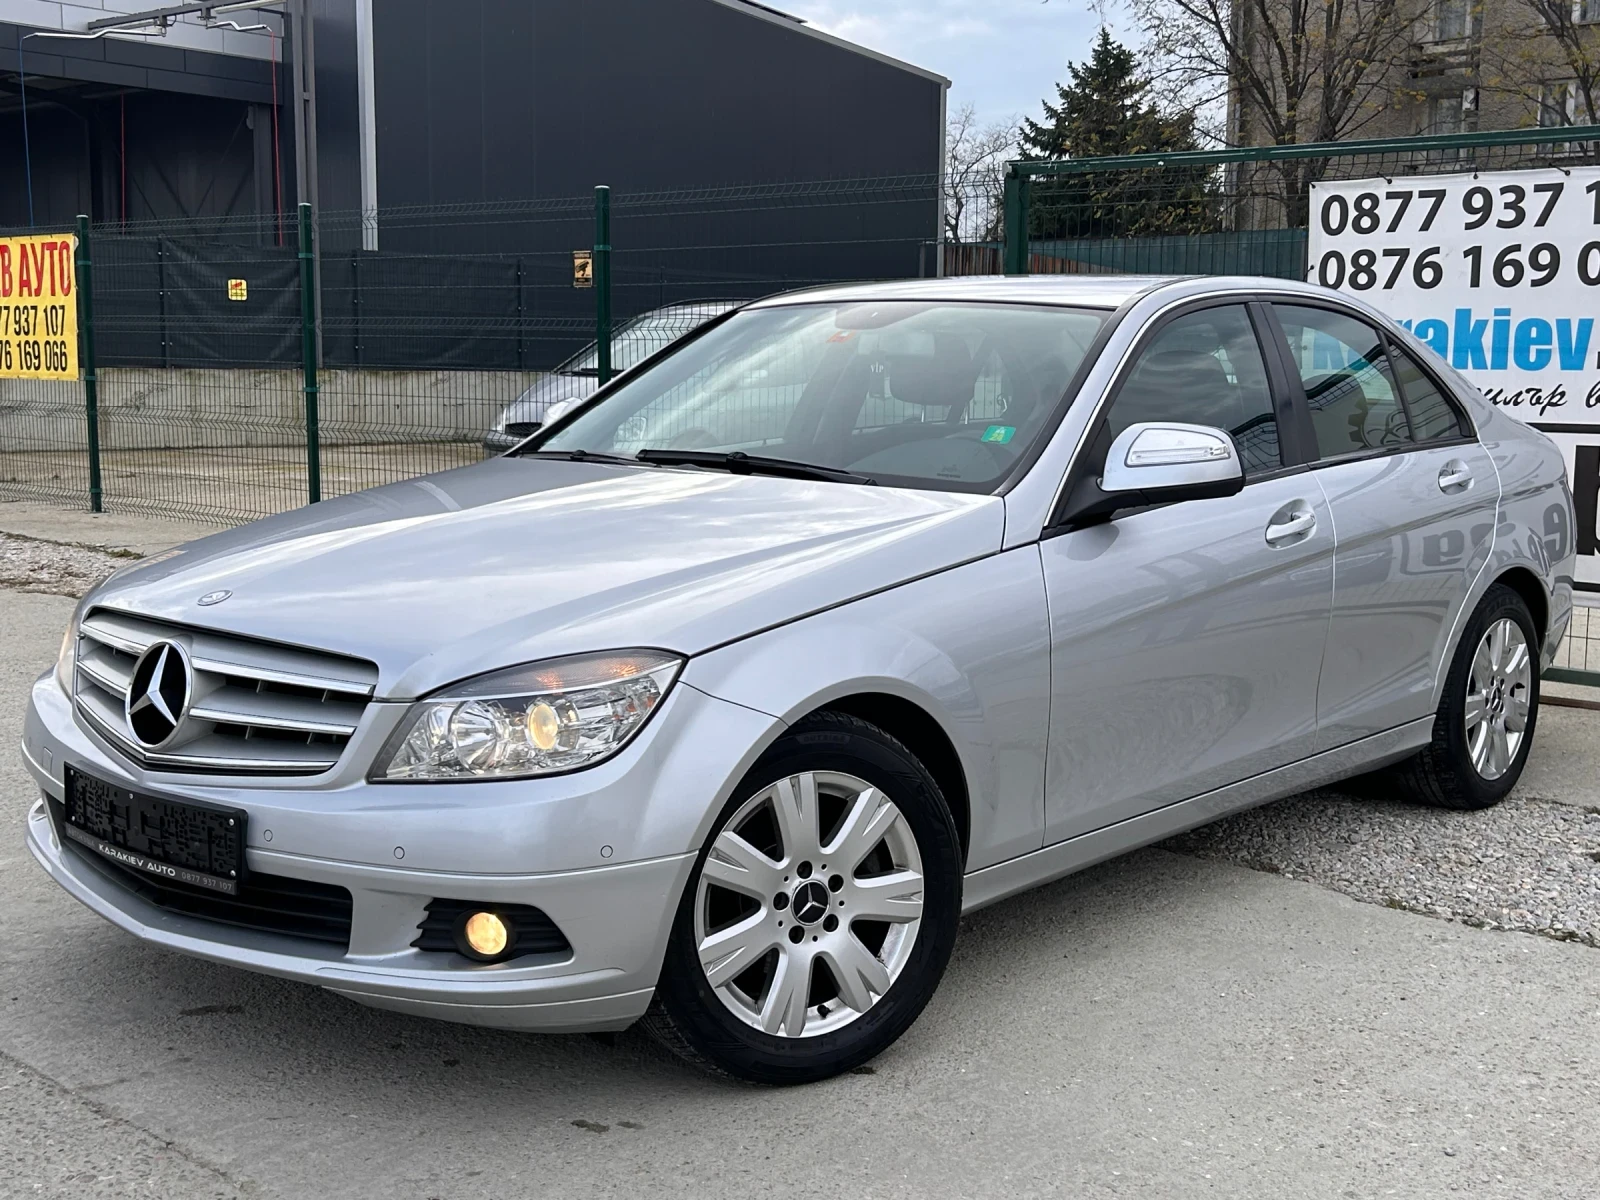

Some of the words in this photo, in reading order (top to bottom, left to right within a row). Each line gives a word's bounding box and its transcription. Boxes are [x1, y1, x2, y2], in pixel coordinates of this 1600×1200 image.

[1321, 189, 1447, 236] 0877
[1462, 182, 1564, 230] 937
[19, 241, 71, 297] АУТО
[1318, 246, 1444, 291] 0876
[1463, 242, 1561, 288] 169
[14, 305, 38, 336] 937
[43, 304, 66, 336] 107
[16, 340, 41, 371] 169
[44, 340, 67, 372] 066
[1476, 383, 1569, 416] илър
[99, 843, 144, 867] KARAKIEV
[147, 861, 176, 877] AUTO
[181, 871, 201, 883] 0877
[203, 877, 217, 887] 937
[220, 881, 232, 891] 107
